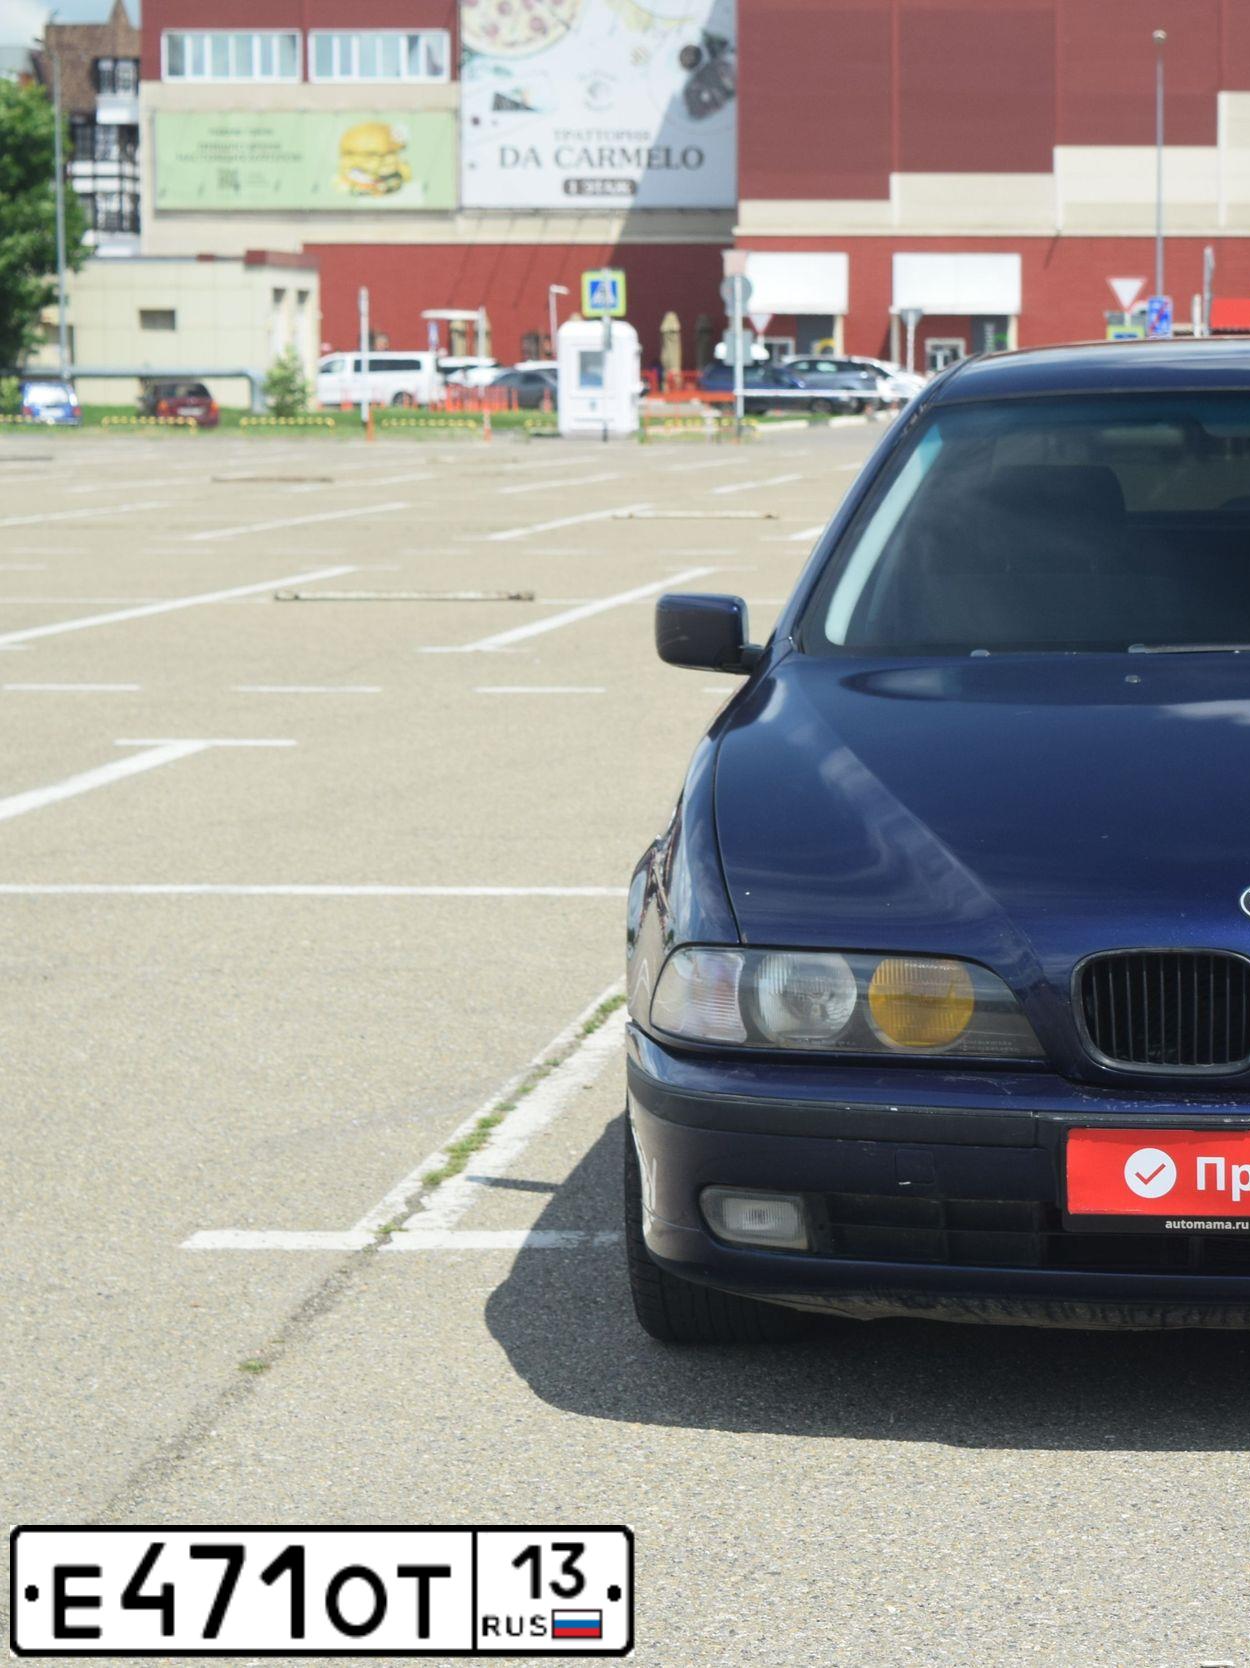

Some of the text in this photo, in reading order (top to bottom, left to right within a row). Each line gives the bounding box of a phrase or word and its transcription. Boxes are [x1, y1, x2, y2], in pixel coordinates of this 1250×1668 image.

[500, 145, 705, 171] DA CARMELO
[1164, 1217, 1250, 1231] automama.ru
